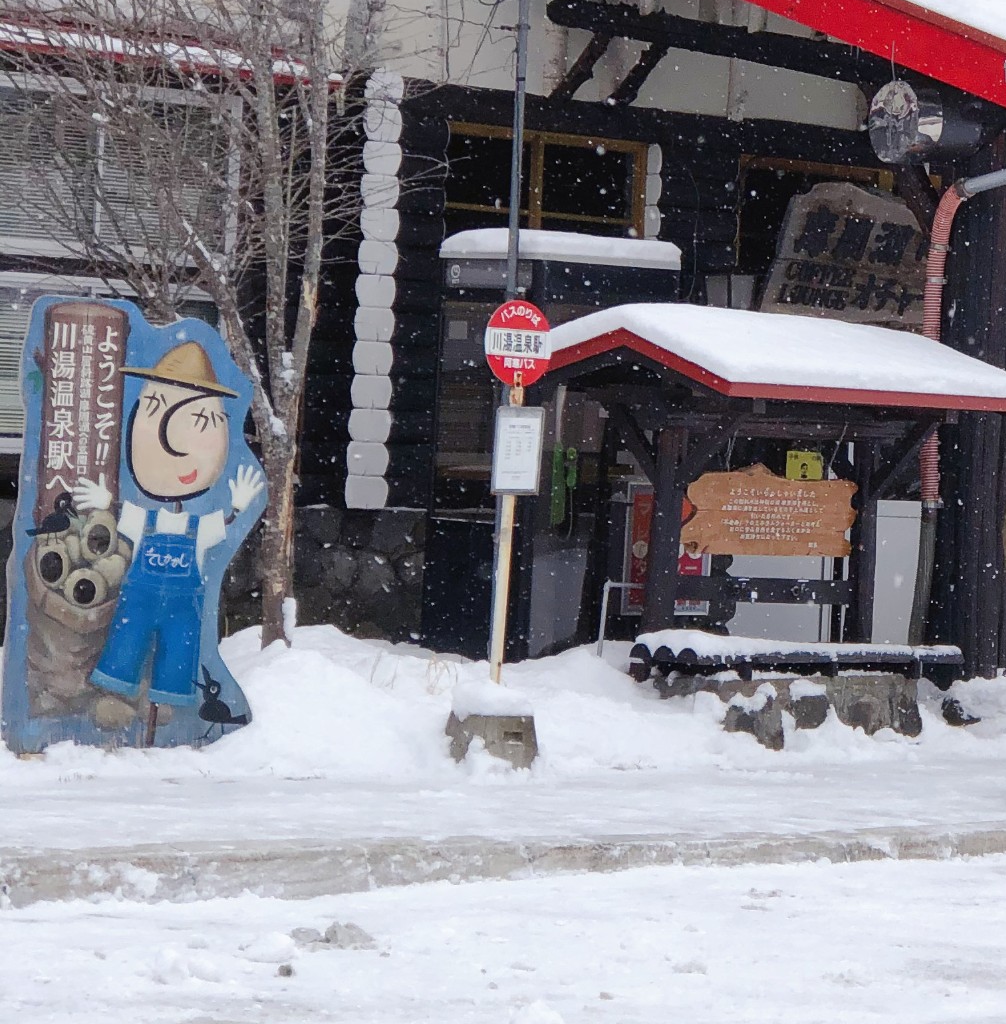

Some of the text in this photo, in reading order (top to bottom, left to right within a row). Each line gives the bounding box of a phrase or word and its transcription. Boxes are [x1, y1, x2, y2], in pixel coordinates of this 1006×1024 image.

[501, 306, 542, 327] バスのりば
[492, 332, 543, 354] 川湯温泉駅
[45, 322, 77, 493] 川湯温泉駅へ
